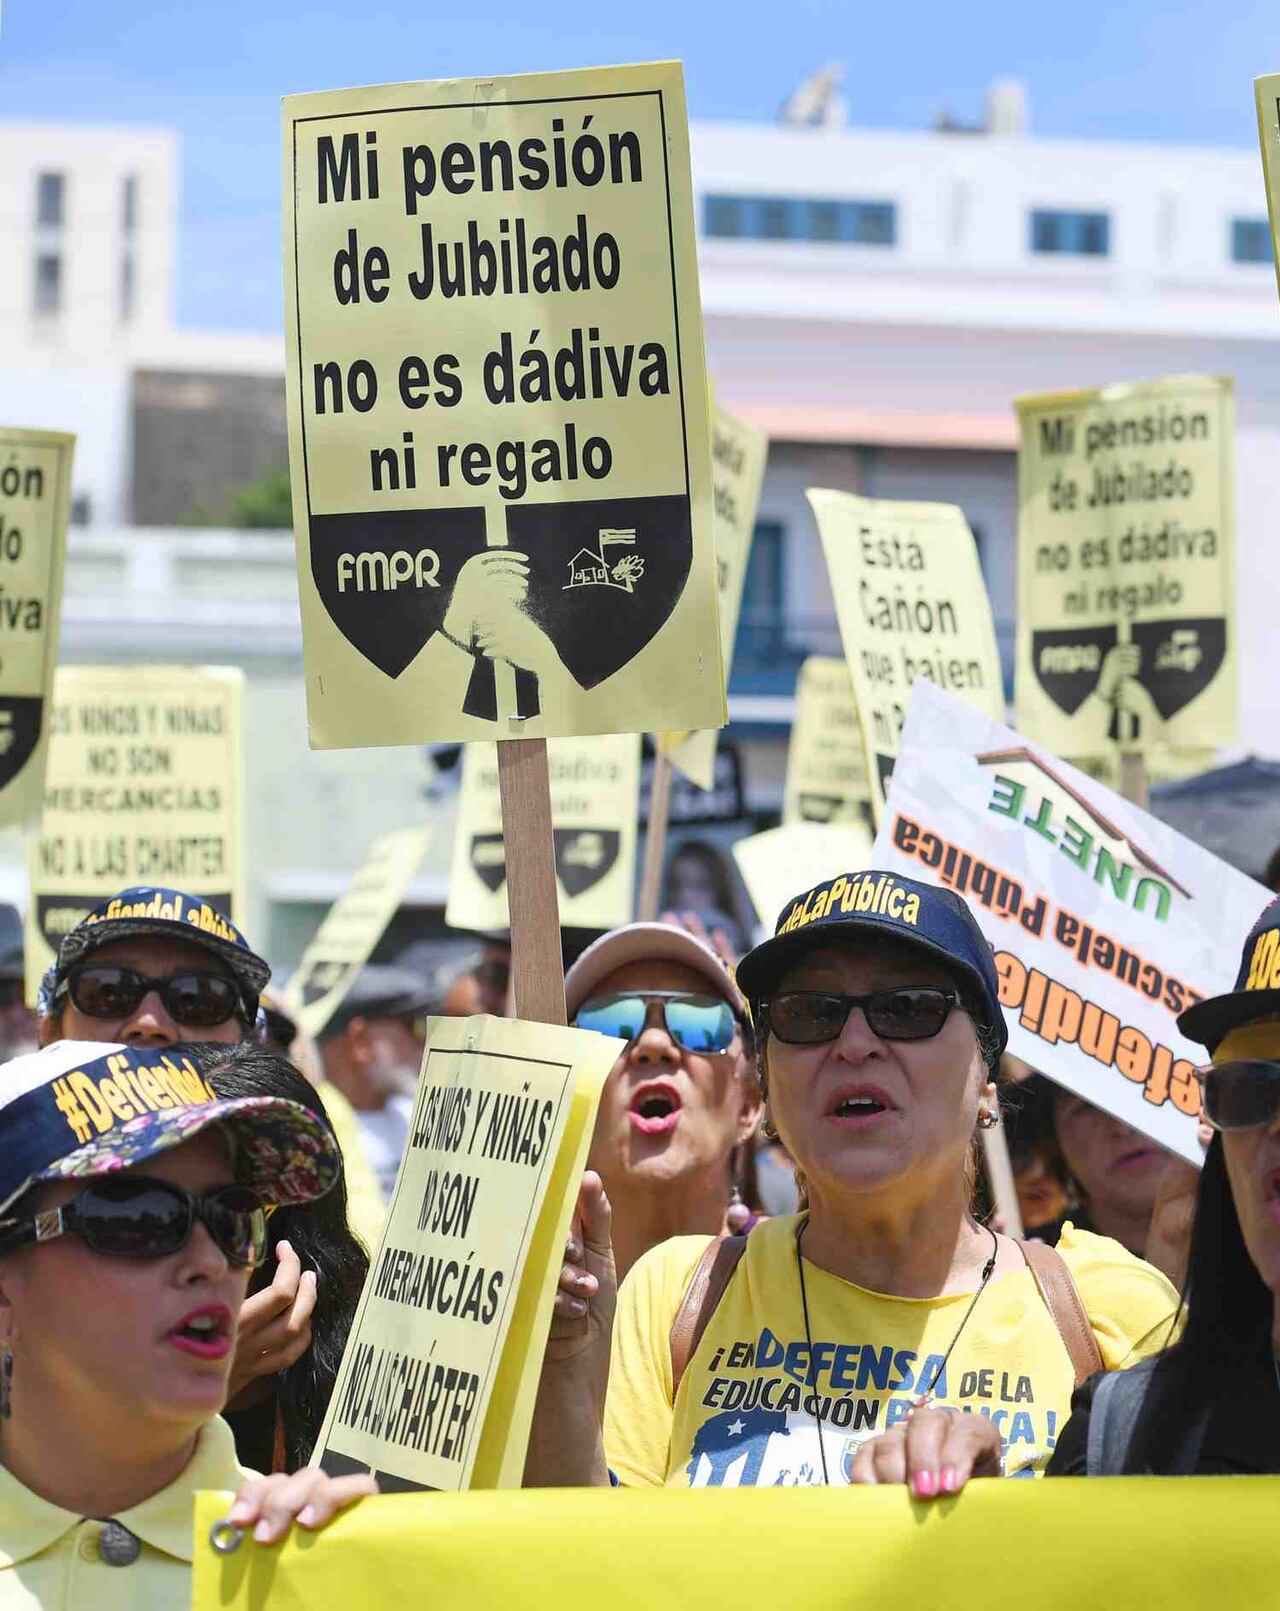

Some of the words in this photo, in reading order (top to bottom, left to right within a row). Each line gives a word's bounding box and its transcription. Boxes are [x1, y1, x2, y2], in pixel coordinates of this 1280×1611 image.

[317, 131, 379, 204] Mi
[402, 115, 643, 216] pensión
[333, 228, 391, 306] de
[407, 214, 621, 301] Jubilado
[313, 358, 378, 415] no
[399, 353, 463, 411] es
[483, 327, 670, 405] dádiva
[370, 431, 417, 491] ni
[437, 422, 613, 500] regalo
[336, 548, 441, 593] FMPR
[1036, 543, 1070, 572] no
[1079, 537, 1110, 569] es
[893, 815, 1047, 938] Pública
[1055, 910, 1207, 1014] scuela
[467, 1090, 491, 1155] Y
[481, 1081, 553, 1168] NIÑAS
[431, 1170, 480, 1239] SON
[375, 1247, 504, 1325] MERANCÍAS
[385, 1340, 479, 1462] CHÁRTER
[702, 1376, 880, 1431] EDUCACIÓN
[755, 1327, 947, 1399] DEFENSA
[959, 1368, 995, 1400] DE
[999, 1372, 1034, 1403] LA
